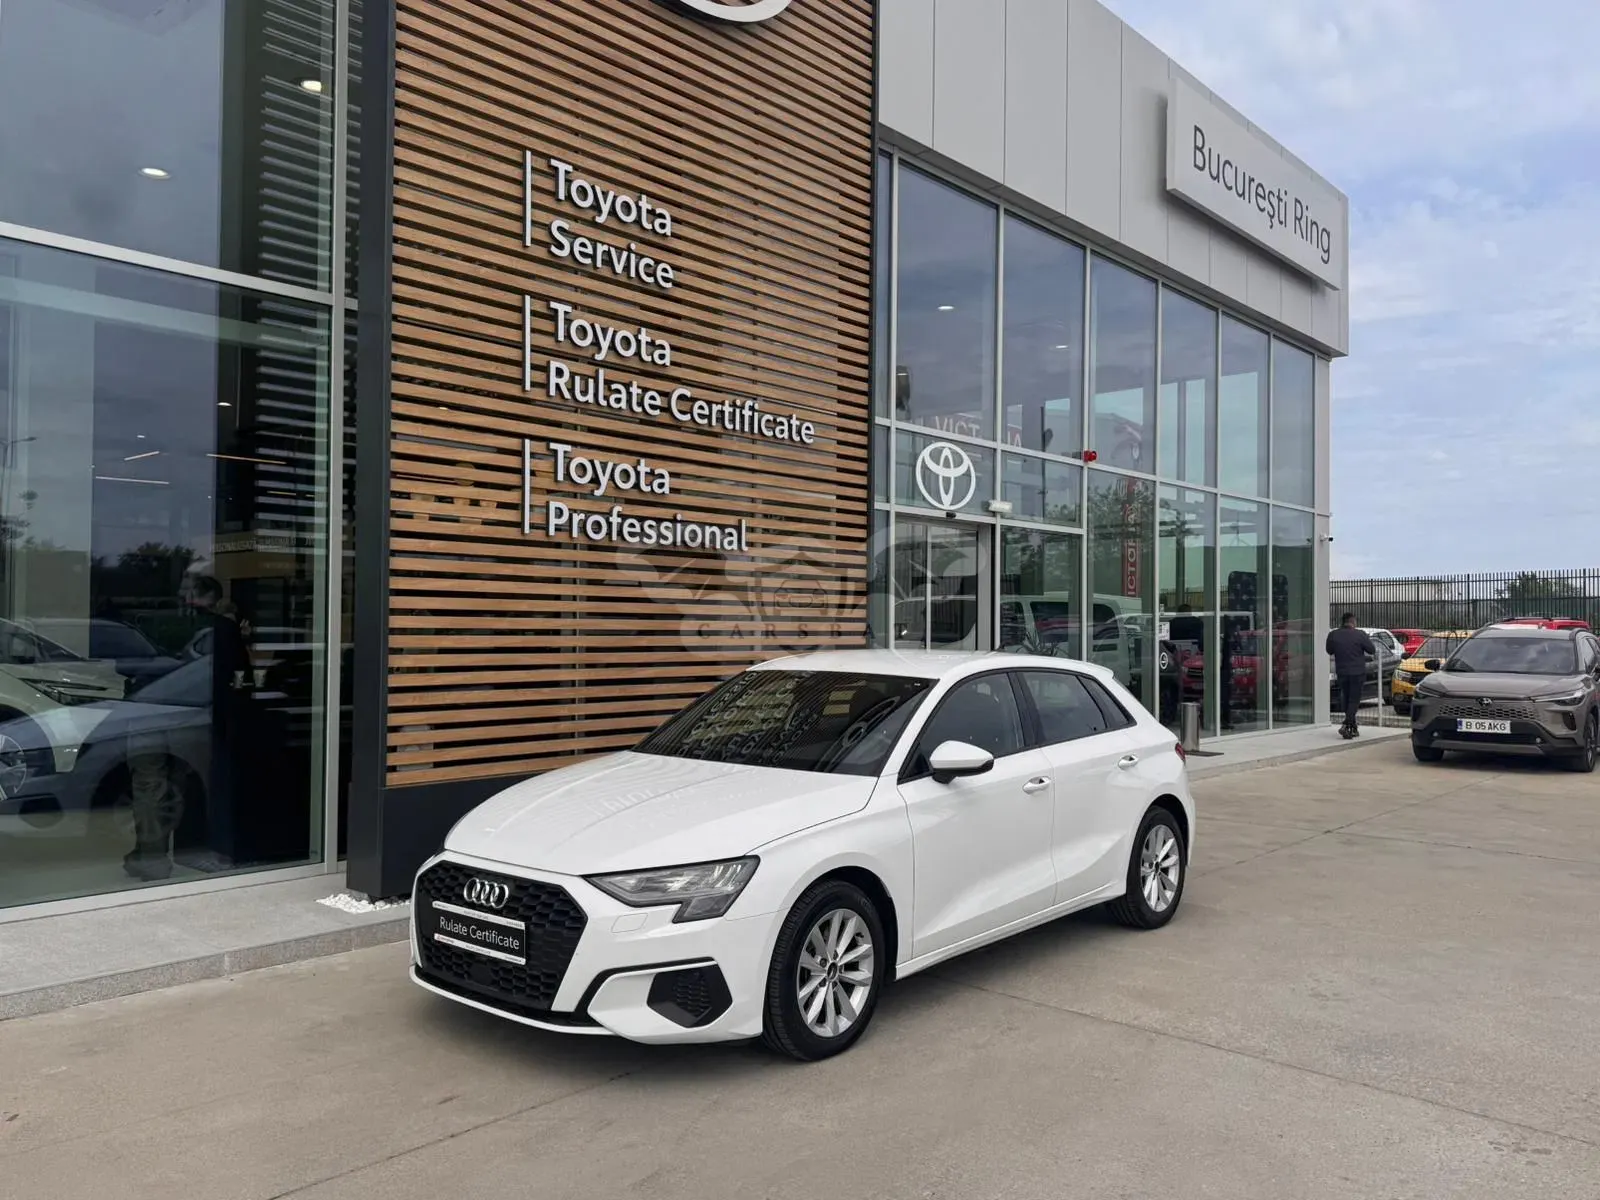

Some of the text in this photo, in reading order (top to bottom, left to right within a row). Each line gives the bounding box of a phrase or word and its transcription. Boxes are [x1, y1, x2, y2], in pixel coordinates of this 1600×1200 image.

[550, 159, 672, 237] Toyota
[1294, 197, 1331, 265] Ring
[550, 219, 675, 288] Service
[549, 301, 671, 367] Toyota
[549, 360, 815, 445] Rulate Certificate
[549, 442, 671, 497] Toyota
[548, 501, 749, 552] Professional
[1465, 721, 1506, 731] B 05 AKG
[439, 916, 468, 936] Rulate
[469, 925, 520, 950] Certificate
